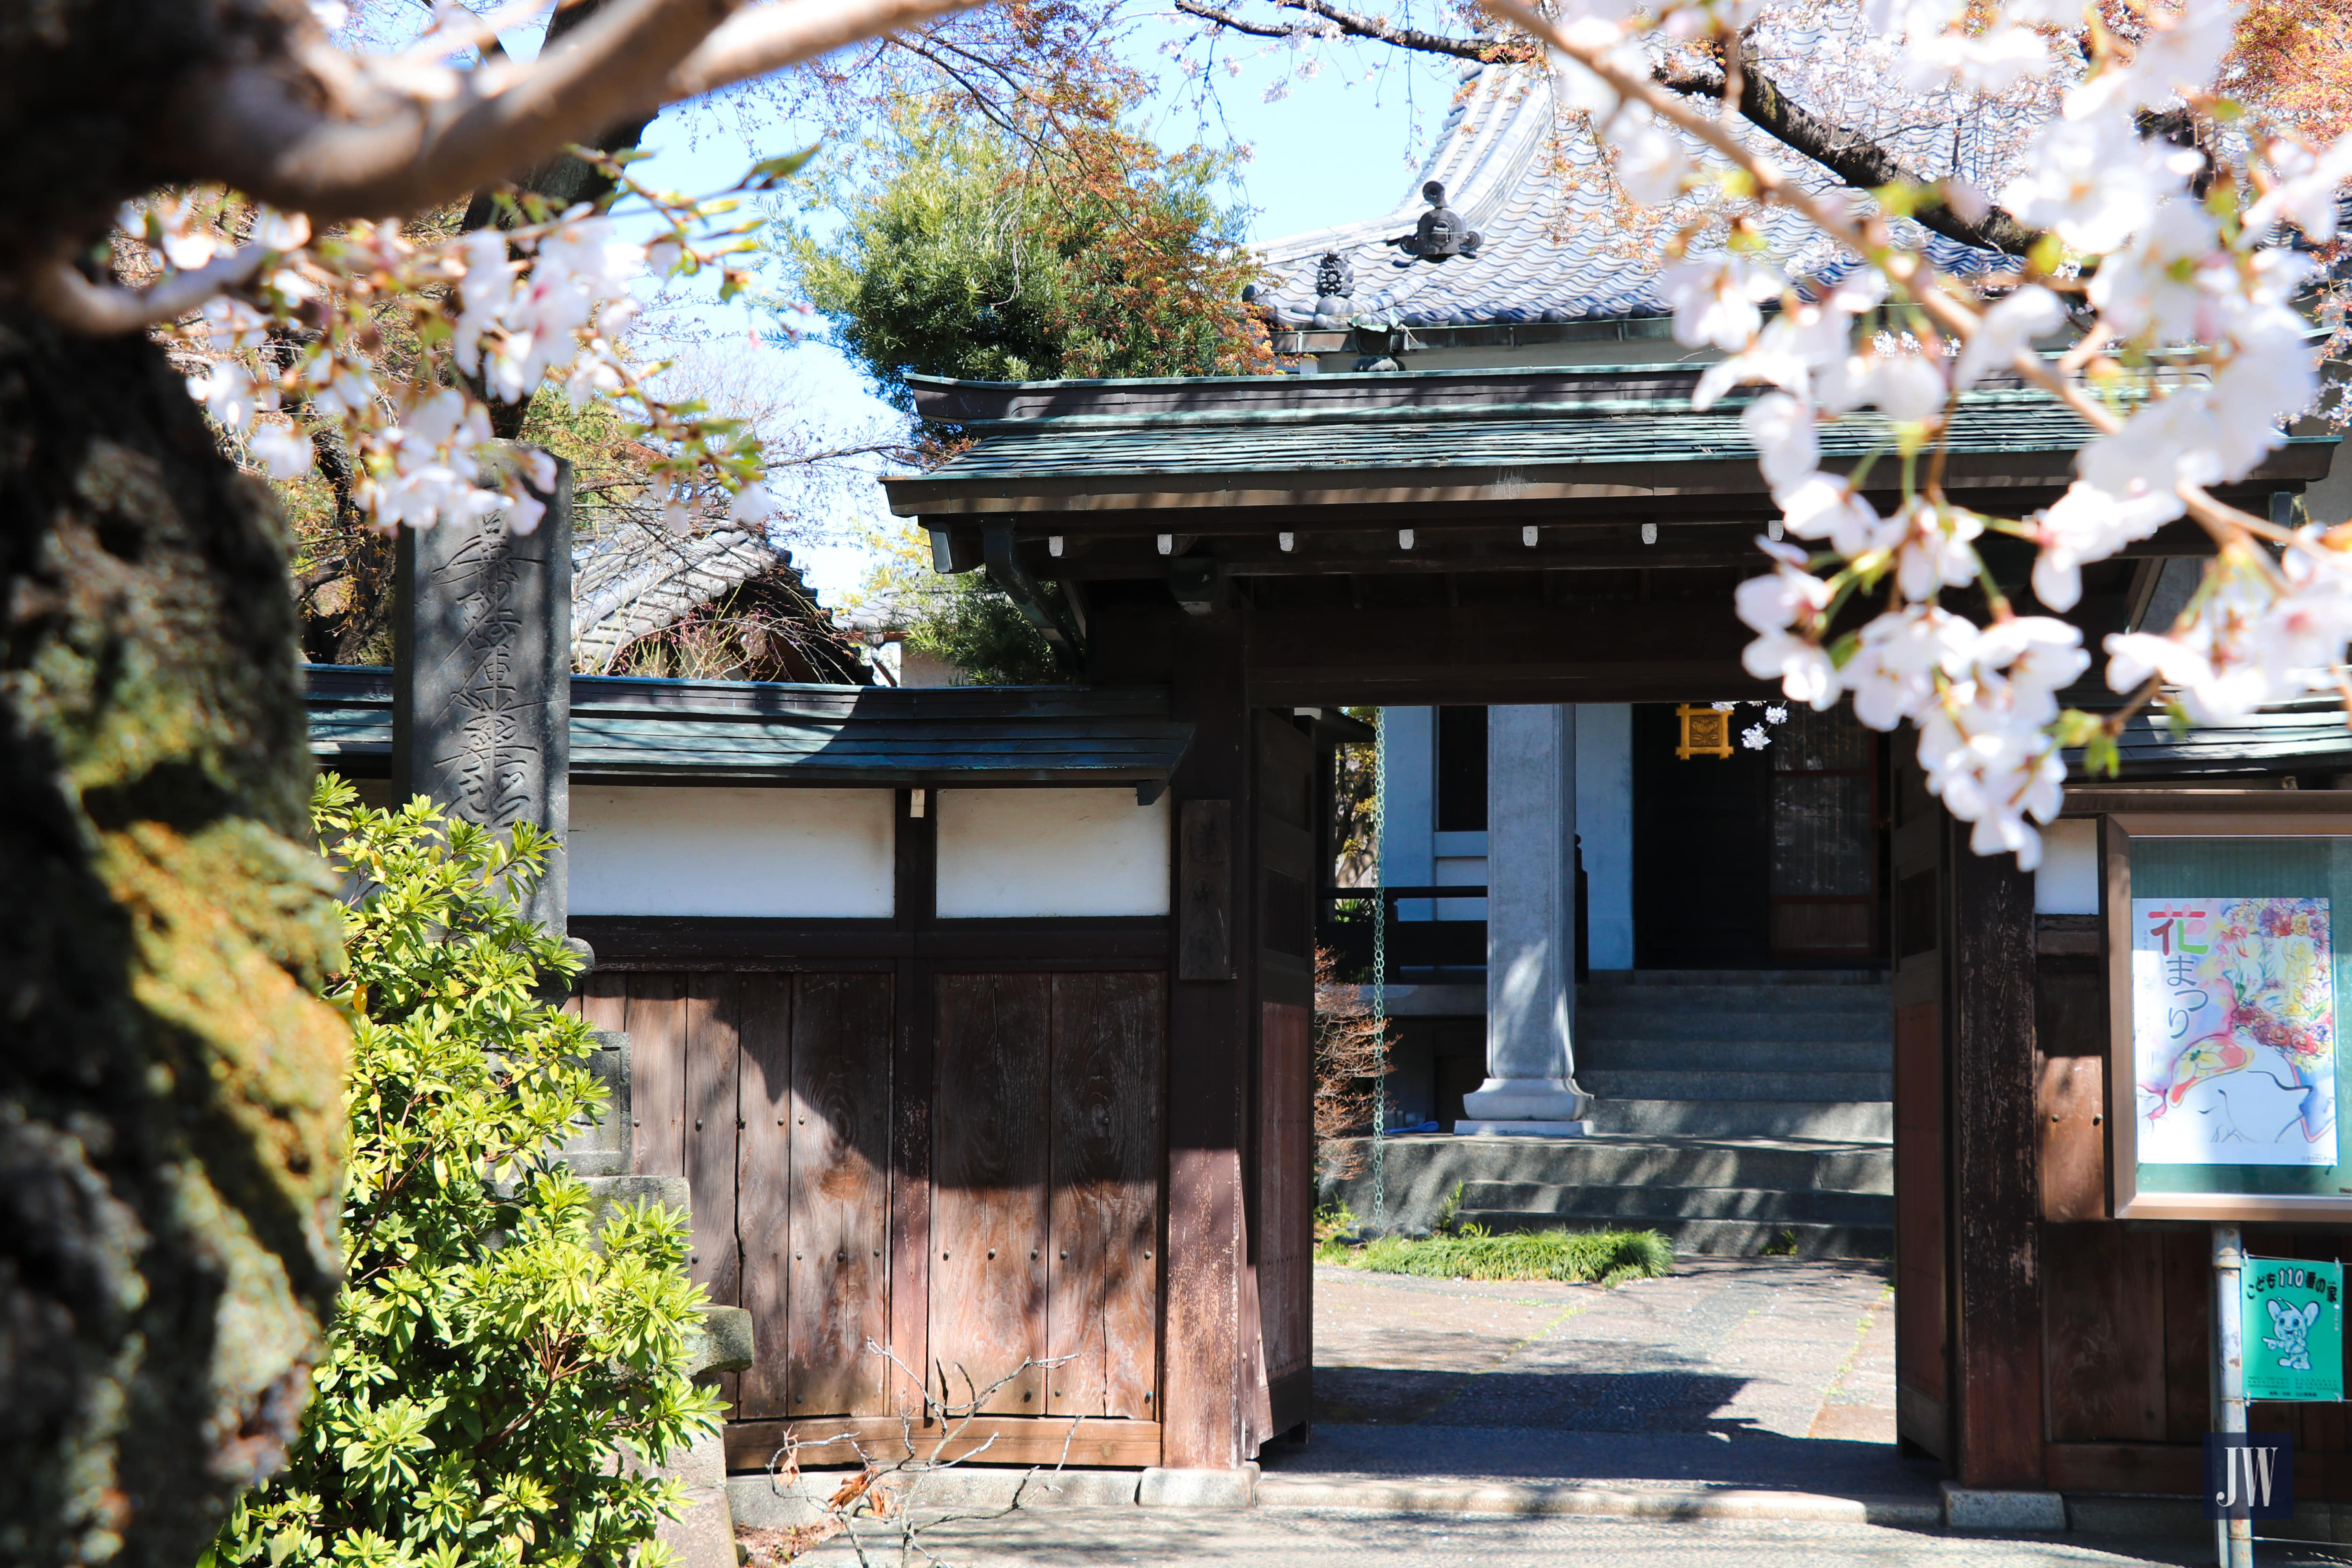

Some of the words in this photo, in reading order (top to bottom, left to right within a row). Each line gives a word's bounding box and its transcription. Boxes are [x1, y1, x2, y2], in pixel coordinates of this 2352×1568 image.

[2148, 903, 2209, 1039] 花まつり
[2247, 1266, 2337, 1303] こども110番の家
